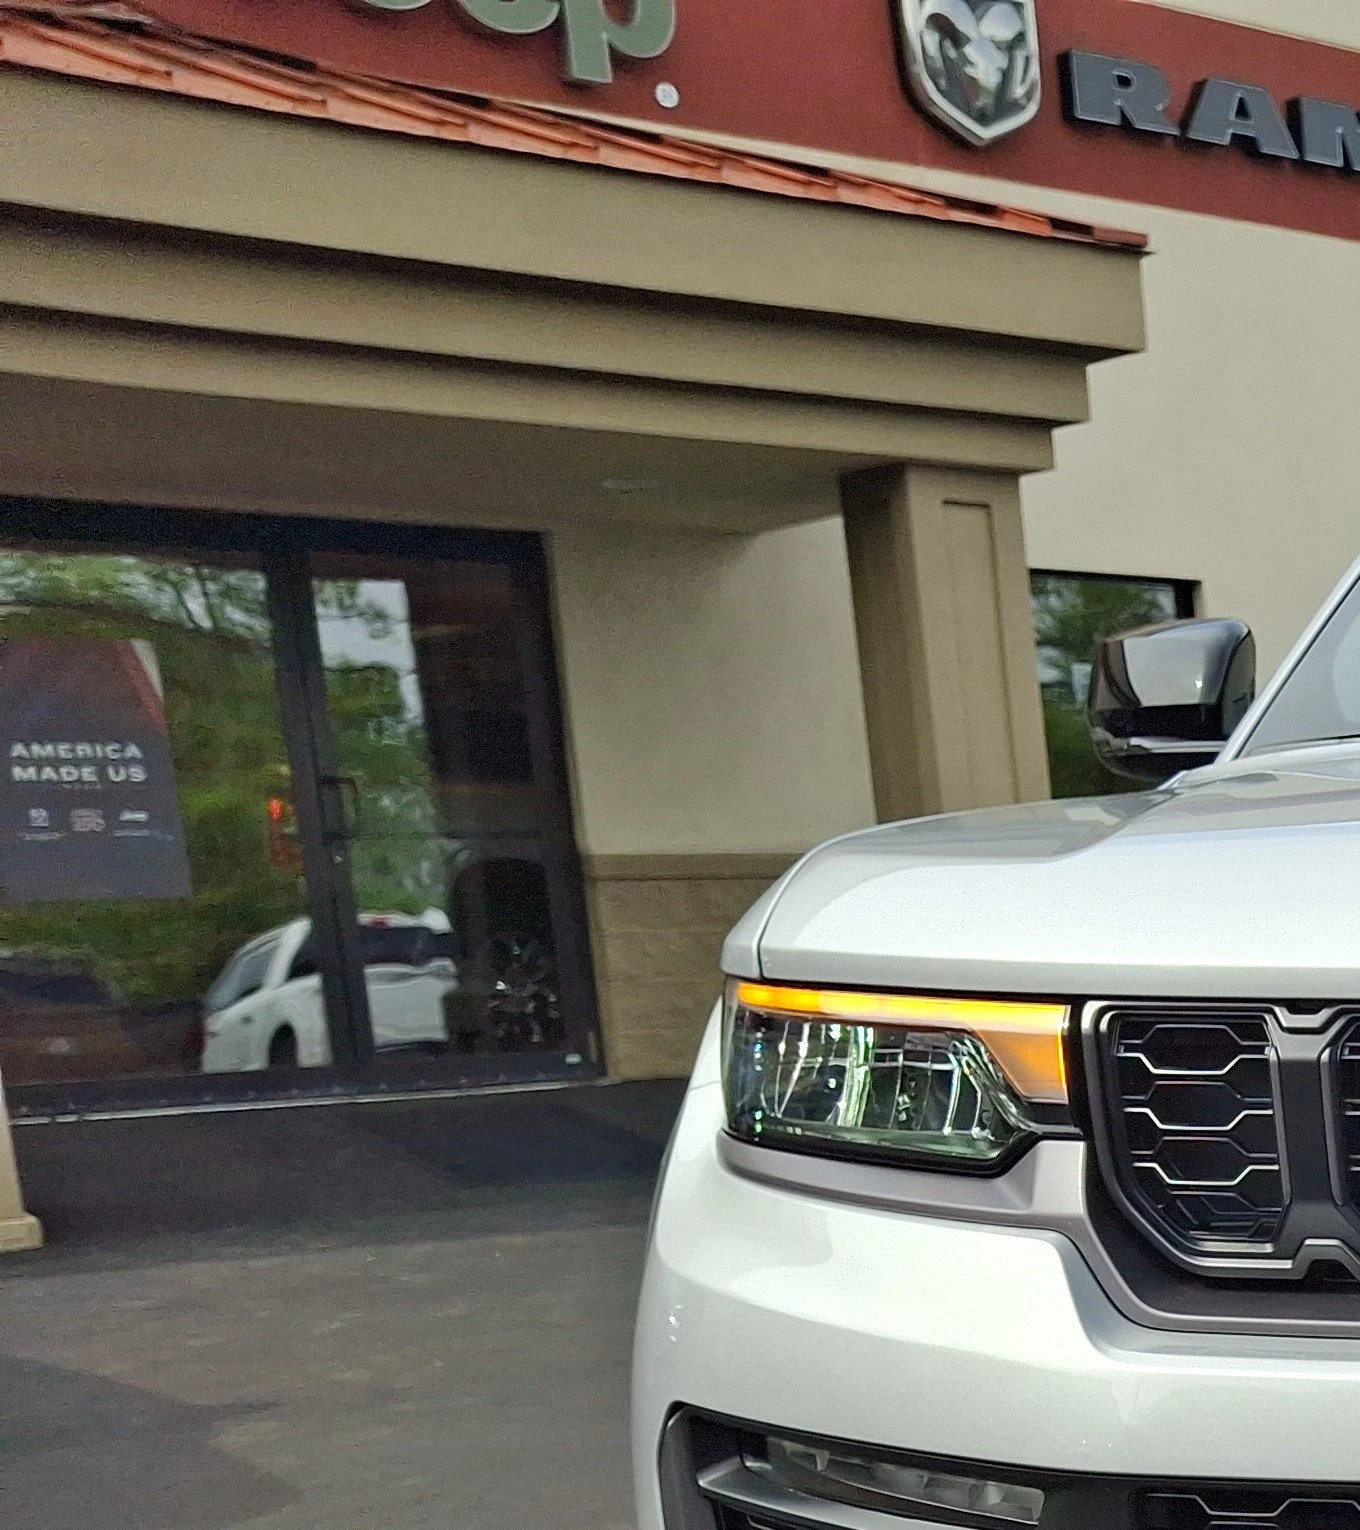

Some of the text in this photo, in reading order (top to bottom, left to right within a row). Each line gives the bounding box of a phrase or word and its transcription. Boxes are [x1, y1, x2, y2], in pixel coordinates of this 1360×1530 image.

[10, 741, 143, 759] AMERICA
[11, 765, 148, 782] MADE US
